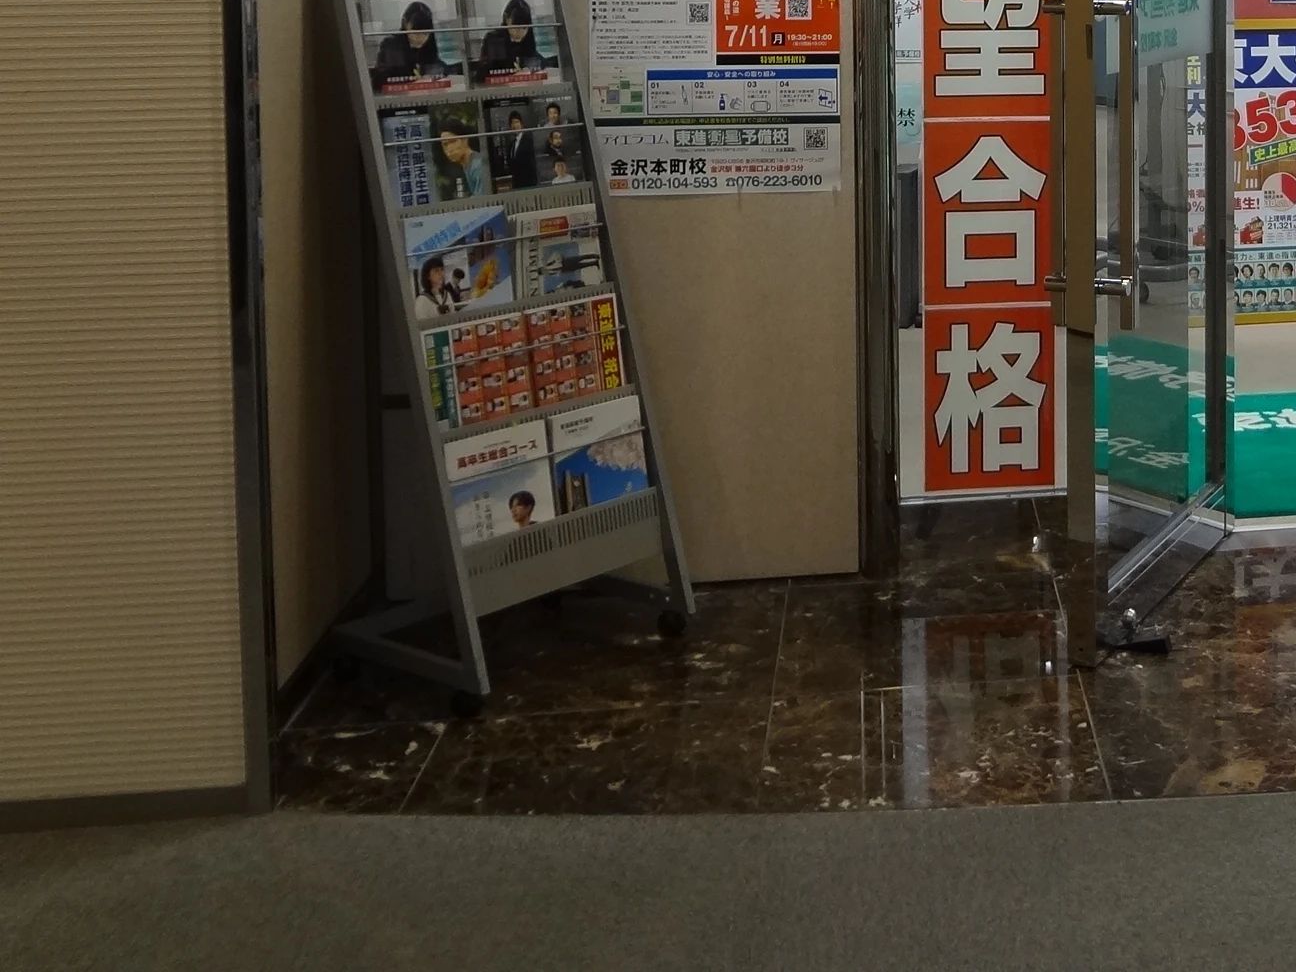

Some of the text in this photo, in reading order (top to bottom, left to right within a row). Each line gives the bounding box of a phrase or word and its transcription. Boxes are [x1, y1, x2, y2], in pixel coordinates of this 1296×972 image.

[725, 25, 767, 47] 7/11
[772, 33, 784, 45] 月
[897, 108, 916, 127] 禁
[675, 129, 789, 146] 東進衛星予備校
[611, 158, 707, 176] 金沢本町校
[632, 177, 718, 189] 0120-104-593
